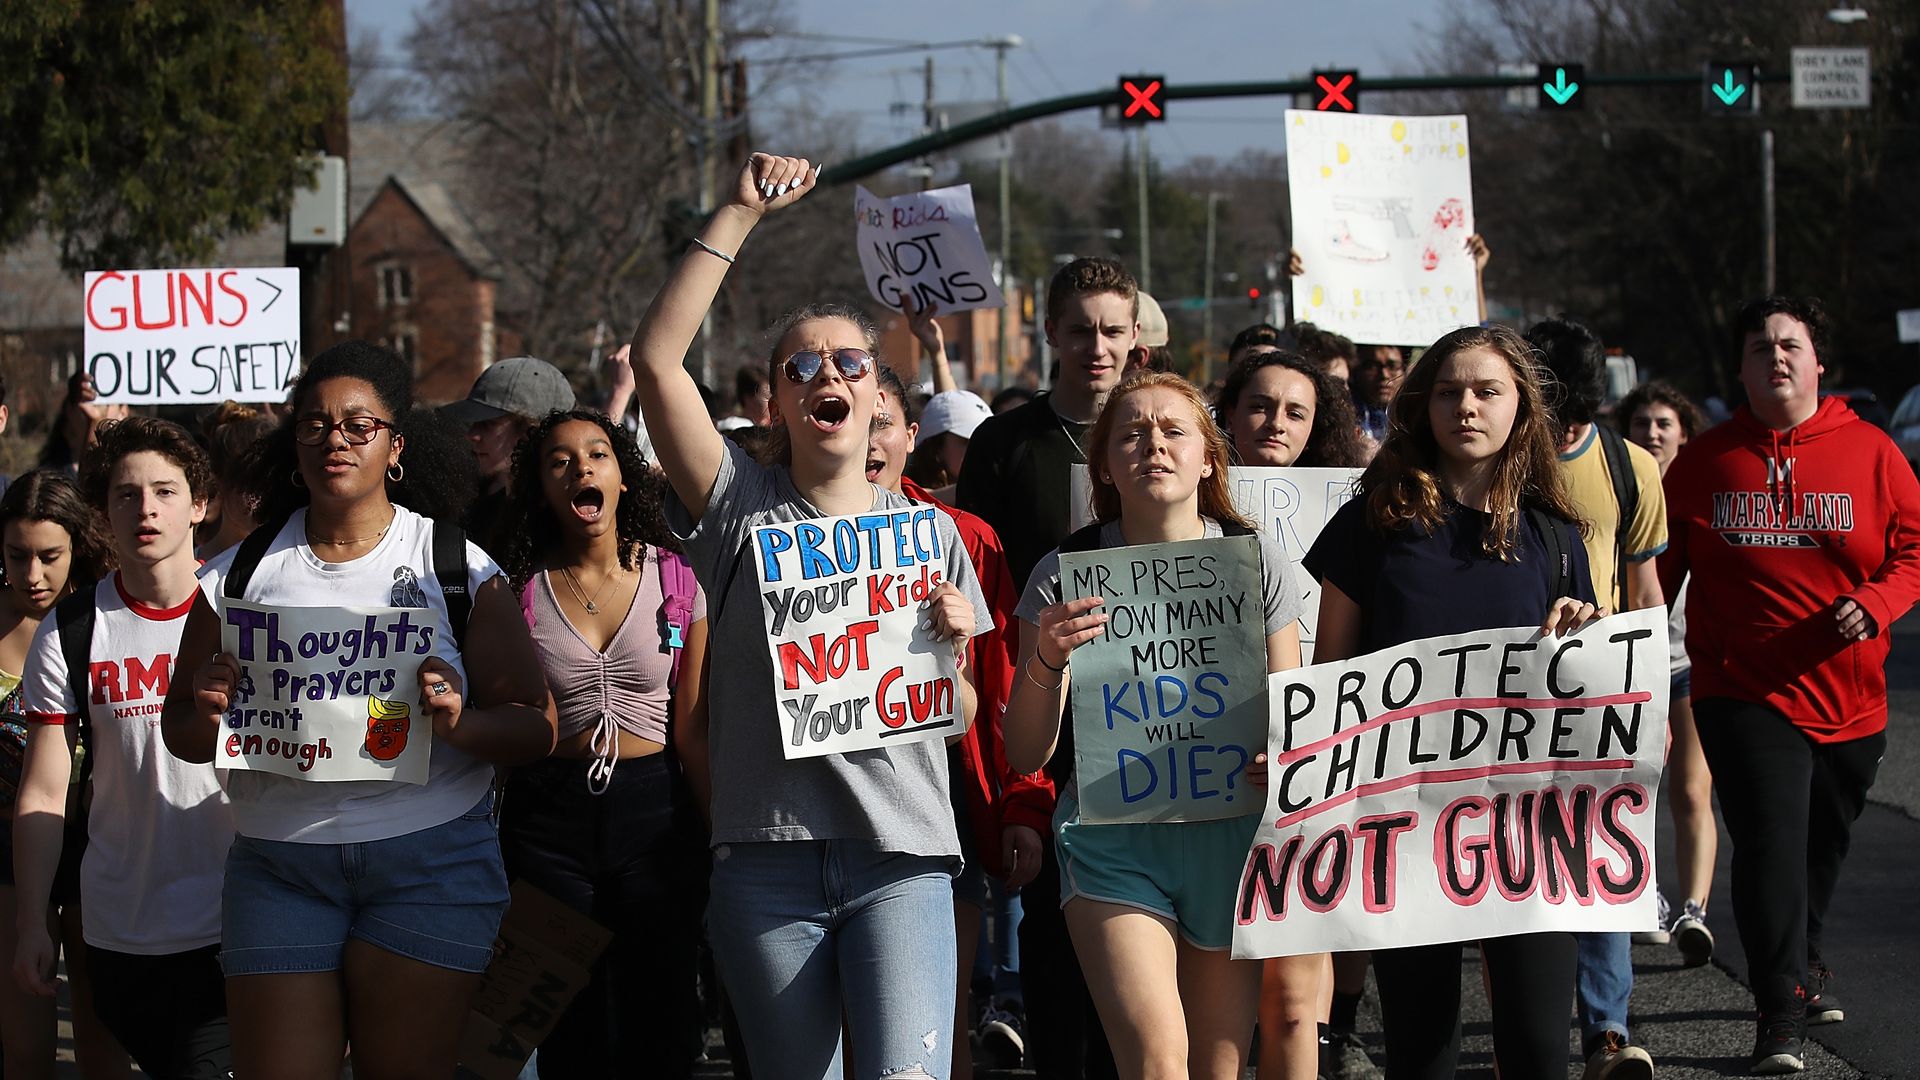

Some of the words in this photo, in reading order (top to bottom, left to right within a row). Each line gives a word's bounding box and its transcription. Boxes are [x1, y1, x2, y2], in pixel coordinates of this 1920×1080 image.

[1390, 119, 1463, 143] OTHER
[873, 233, 941, 278] NOT
[87, 270, 248, 331] GUNS
[877, 271, 987, 316] GUNS
[90, 348, 182, 398] OUR
[190, 340, 298, 396] SAFETY
[1711, 491, 1854, 532] MARYLAND
[756, 508, 941, 582] PROTECT
[1738, 533, 1801, 546] TERPS
[867, 565, 942, 616] Kids
[1073, 564, 1124, 600] MR.
[1131, 555, 1225, 597] PRES,
[226, 606, 434, 668] Thoughts
[1166, 592, 1246, 634] MANY
[776, 620, 879, 690] NOT
[1131, 636, 1219, 676] MORE
[272, 668, 396, 703] Prayers
[782, 694, 870, 746] Your
[875, 666, 954, 728] Gun
[1103, 672, 1229, 730] KIDS
[1283, 629, 1653, 753] PROTECT
[228, 704, 303, 732] aren't
[1145, 722, 1205, 744] WILL
[225, 733, 333, 772] enough
[1118, 744, 1249, 803] DIE?
[1278, 703, 1642, 814] CHILDREN
[1237, 811, 1419, 926] NOT
[1432, 782, 1651, 907] GUNS
[486, 970, 568, 1058] NRA
